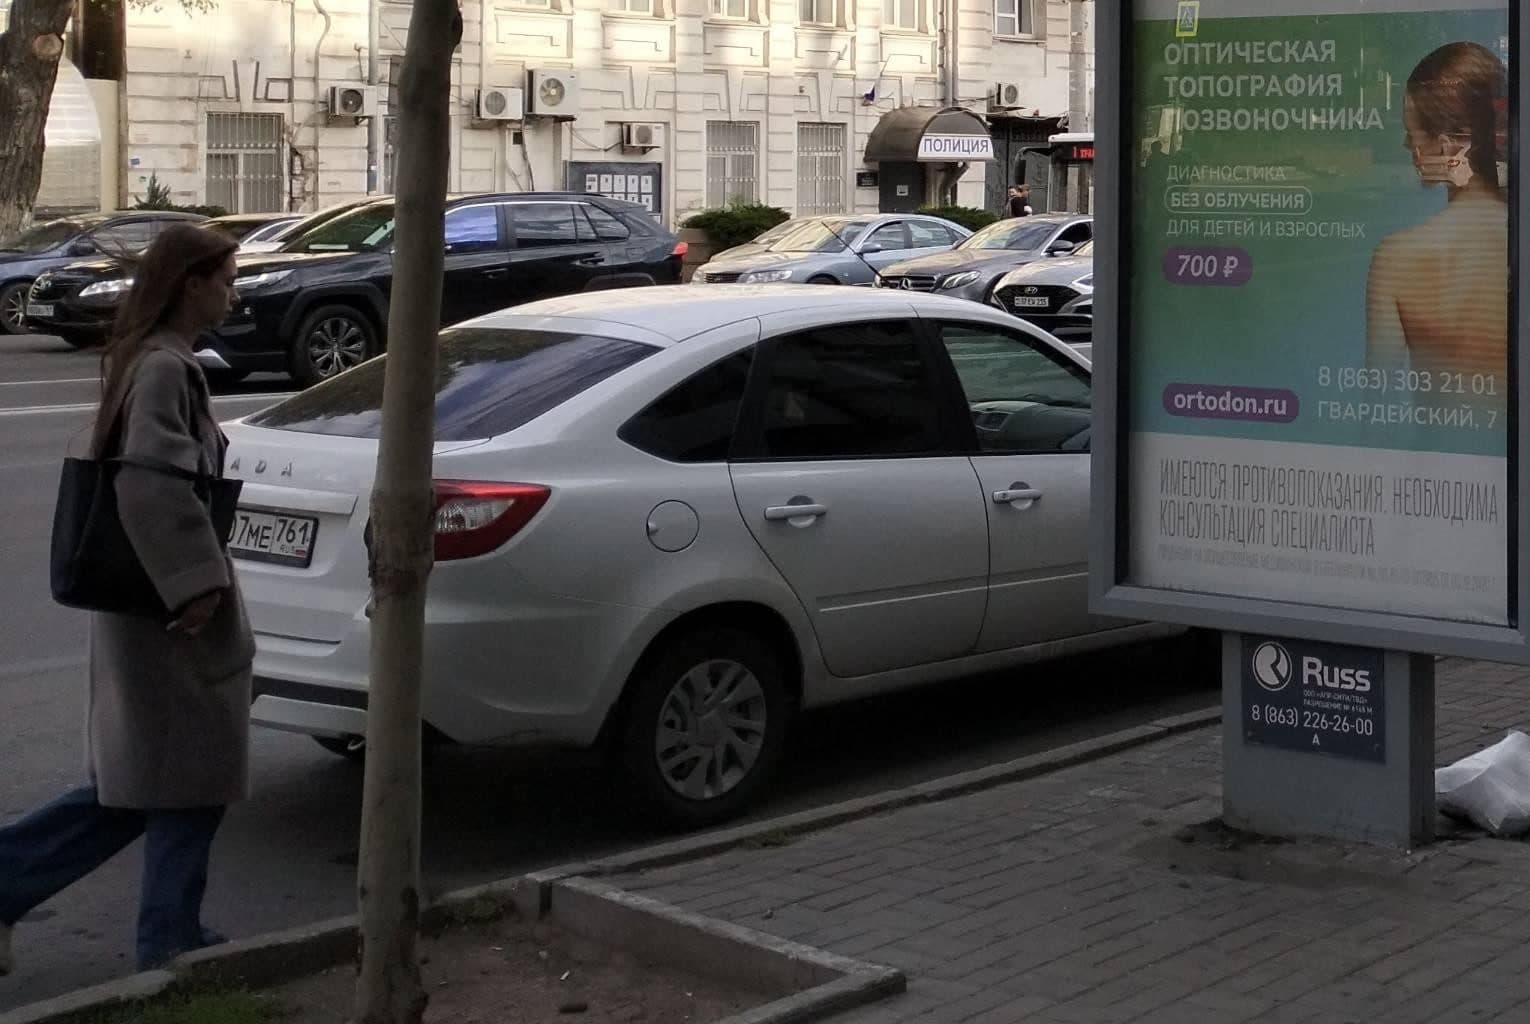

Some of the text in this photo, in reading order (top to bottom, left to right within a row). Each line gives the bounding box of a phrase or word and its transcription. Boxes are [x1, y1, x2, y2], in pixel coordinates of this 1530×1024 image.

[1164, 40, 1336, 64] ОПТИЧЕСКАЯ
[1164, 73, 1342, 97] ТОПОГРАФИЯ
[1176, 107, 1384, 131] ОЗВОНОЧНИКА
[923, 138, 989, 154] ПОЛИЦИЯ
[1167, 165, 1286, 182] ДИАГНОСТИКА
[1171, 192, 1304, 209] БЕЗ ОБЛУЧЕНИЯ
[1166, 218, 1366, 239] ДЛЯ ДЕТЕЙ И ВЗРОСЛЫХ
[1177, 255, 1218, 277] 700
[1318, 366, 1497, 395] 8 (863) 303 21 01
[1174, 391, 1287, 415] ortodon.ru
[1318, 400, 1497, 429] ГВАРДЕЙСКИЙ, 7
[230, 458, 292, 477] ADA
[1160, 459, 1498, 528] ИМЕЮТСЯ ПРОТИВОПОКАЗАНИЯ. НЕОБХОДИМА
[276, 519, 308, 545] 761
[1160, 500, 1375, 556] КОНСУЛЬТАЦИЯ СПЕЦИАЛИСТА
[1302, 656, 1371, 691] Russ
[1252, 704, 1373, 736] 8 (863) 226-26-00
